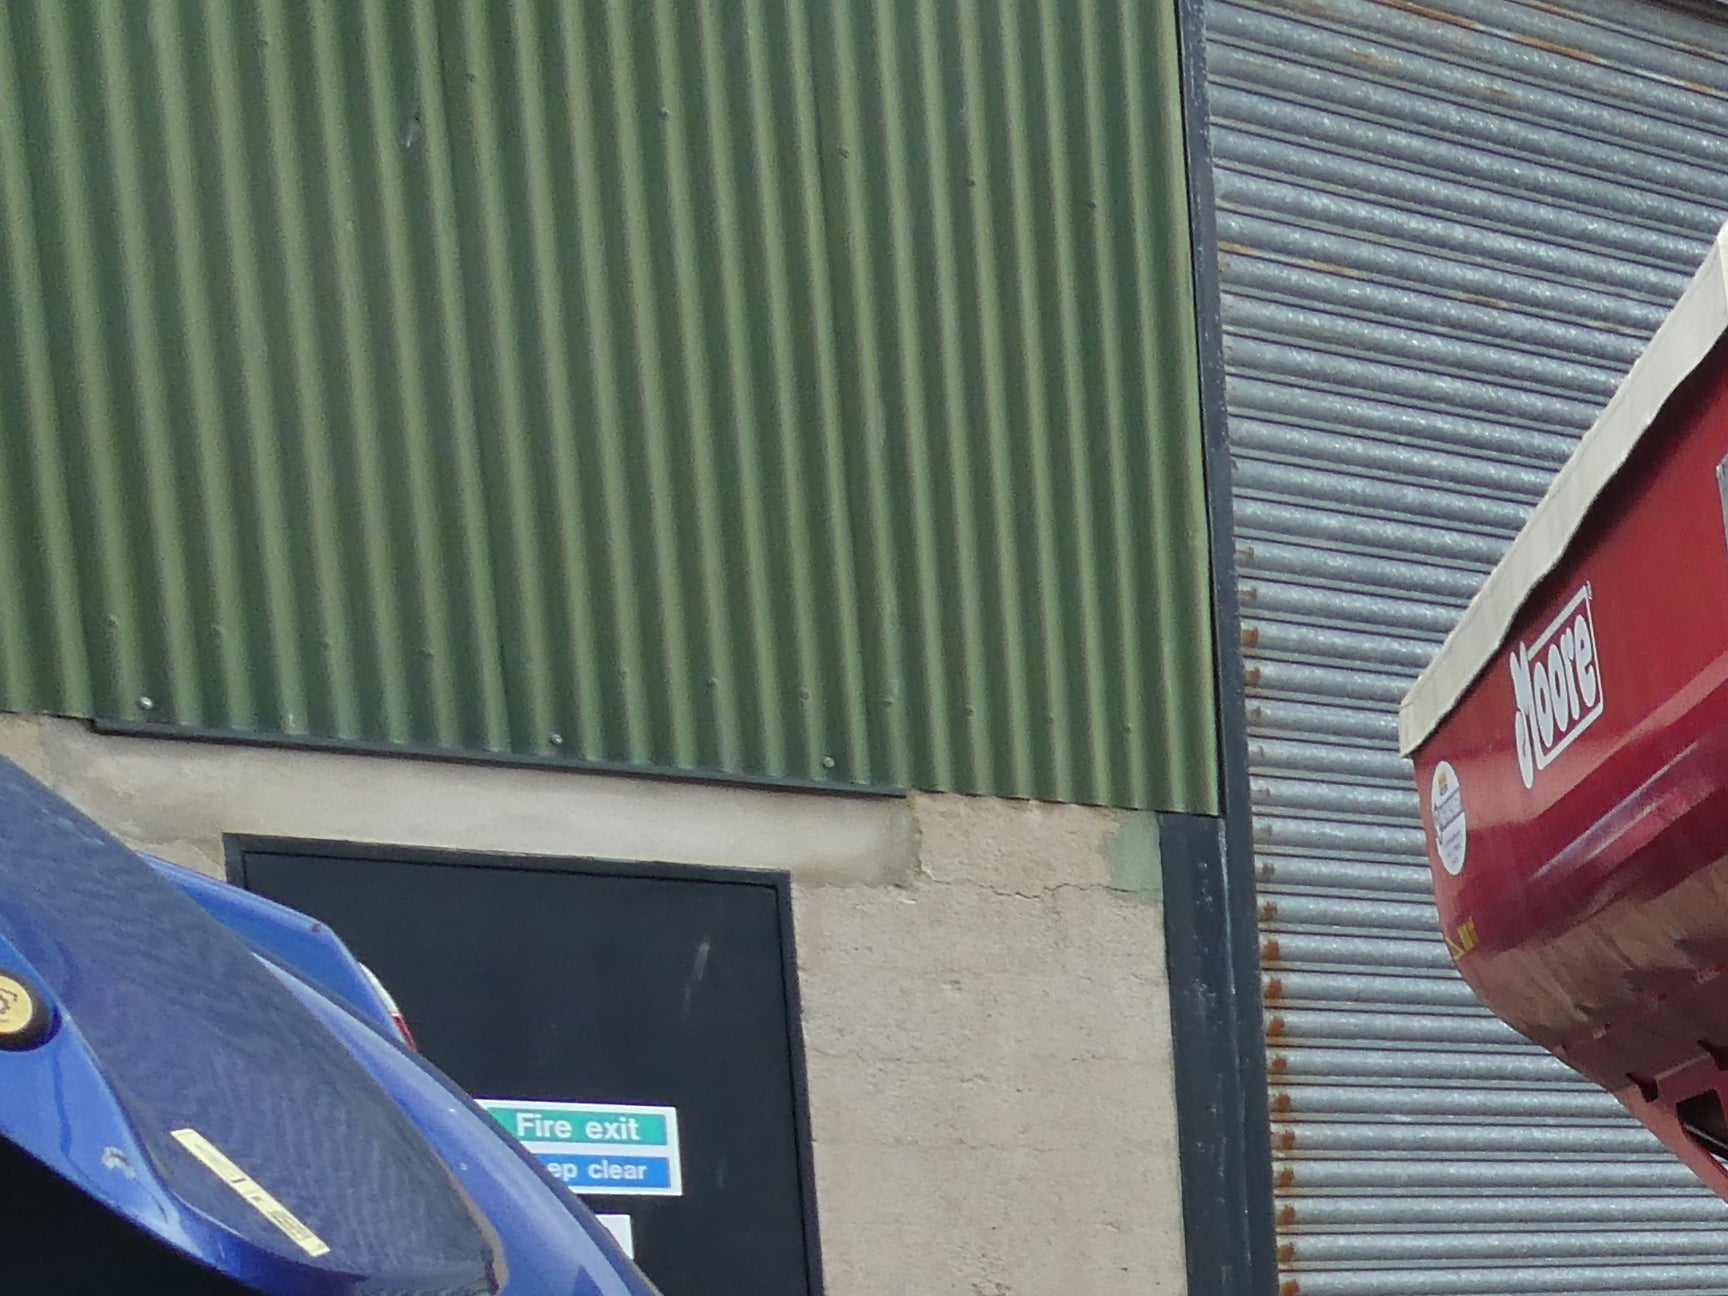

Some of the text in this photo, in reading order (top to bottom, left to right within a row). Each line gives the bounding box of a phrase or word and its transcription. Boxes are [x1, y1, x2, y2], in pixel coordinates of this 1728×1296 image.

[1509, 612, 1598, 790] Moore
[516, 1112, 641, 1141] Fire exit
[547, 1159, 648, 1181] ep clear
